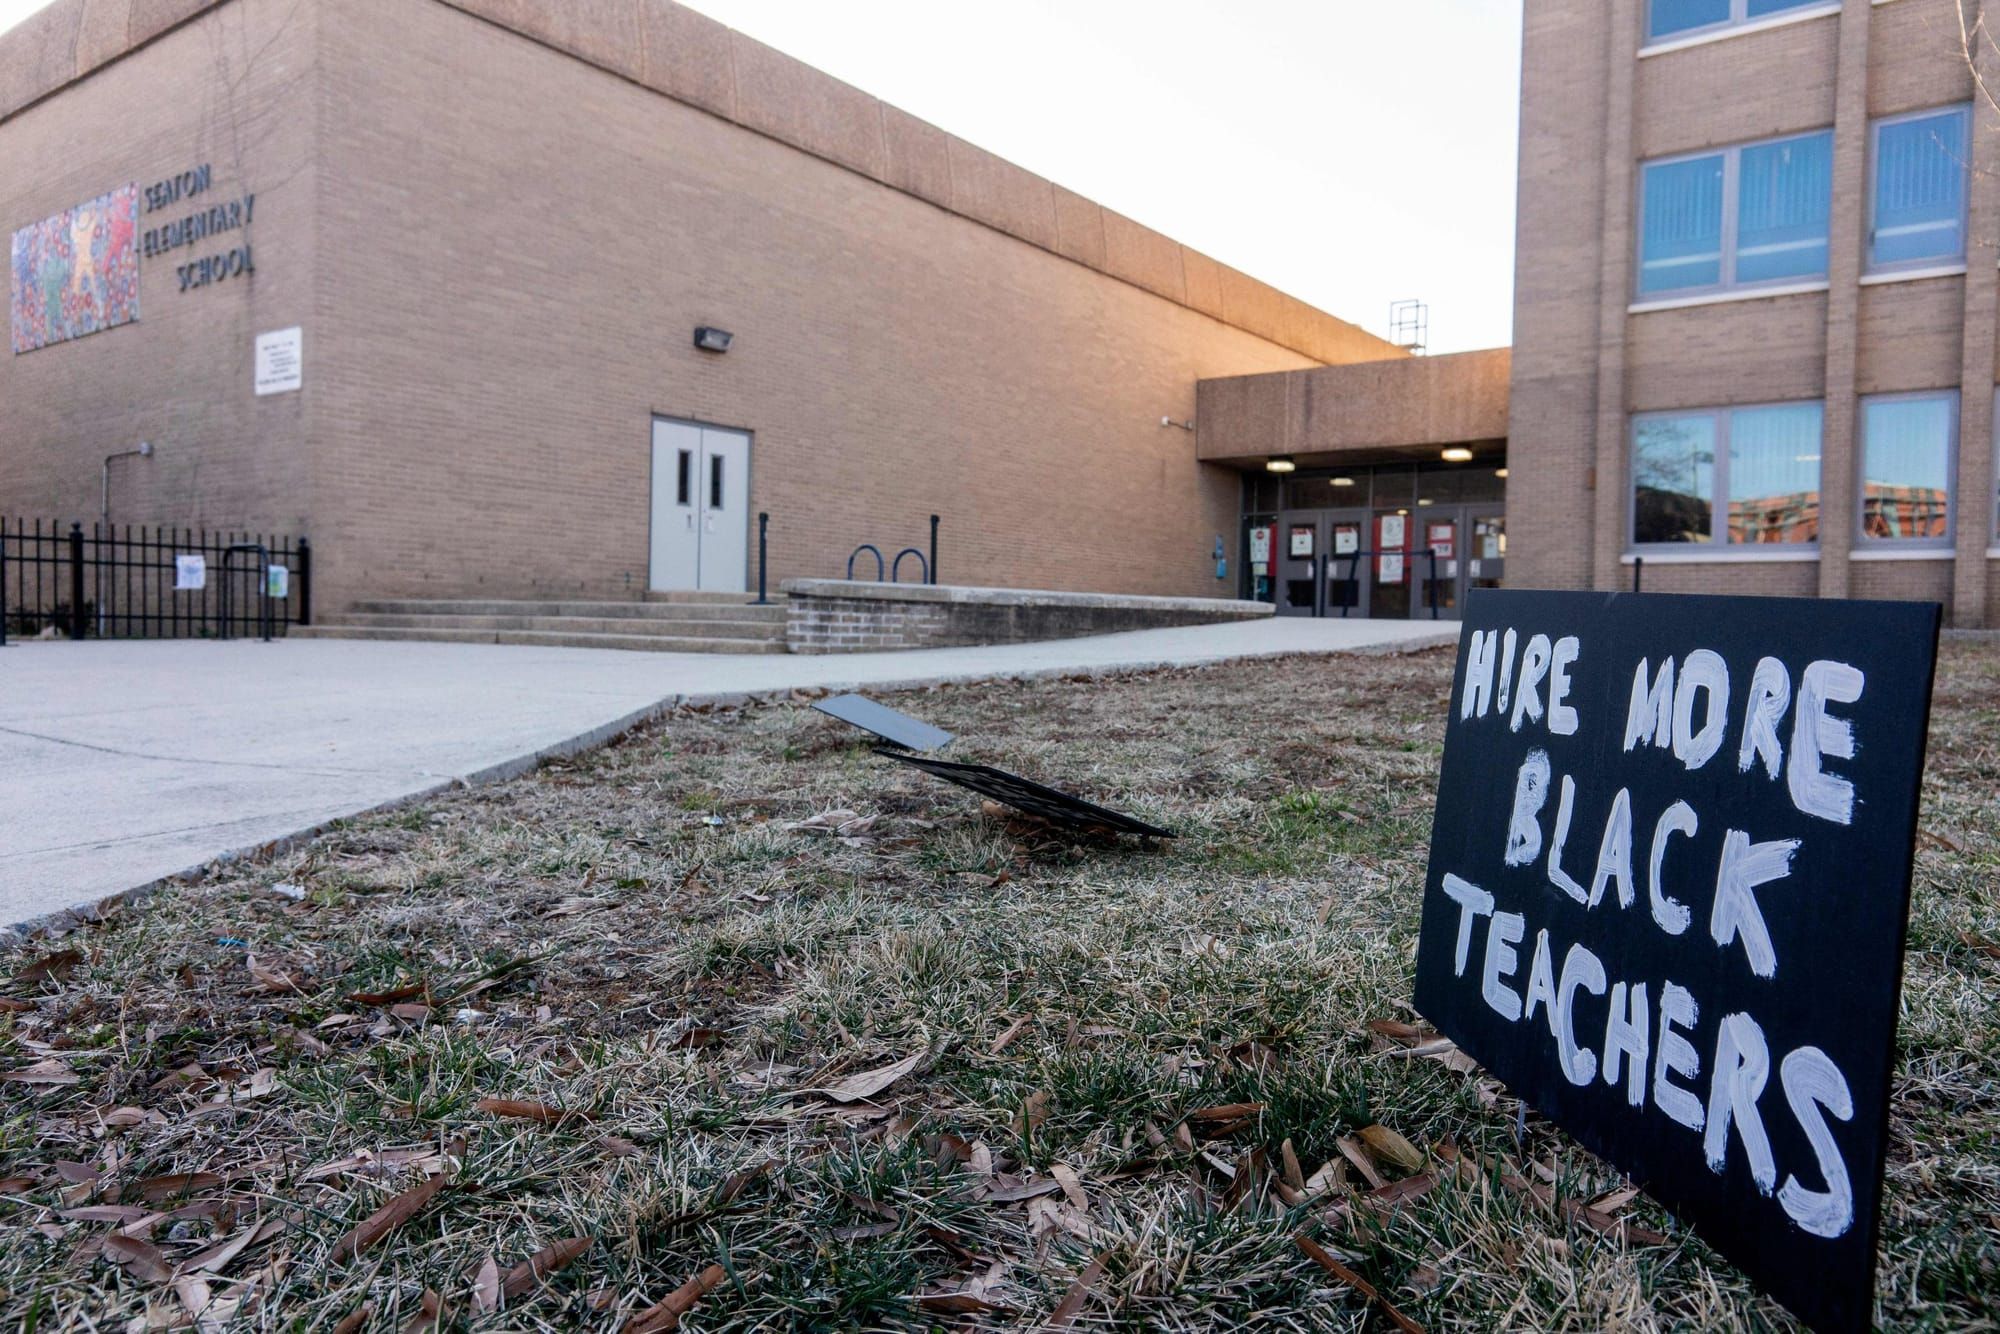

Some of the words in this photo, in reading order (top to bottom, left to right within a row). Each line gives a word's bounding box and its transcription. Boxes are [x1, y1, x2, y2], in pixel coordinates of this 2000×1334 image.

[143, 193, 255, 258] ELEMENTARY
[144, 163, 211, 213] SEATON
[176, 245, 255, 292] SCHOOL
[1460, 626, 1580, 736] HIRE
[1623, 648, 1865, 825] MORE
[1504, 748, 1803, 979] BLACK
[1441, 872, 1855, 1239] TEACHERS
